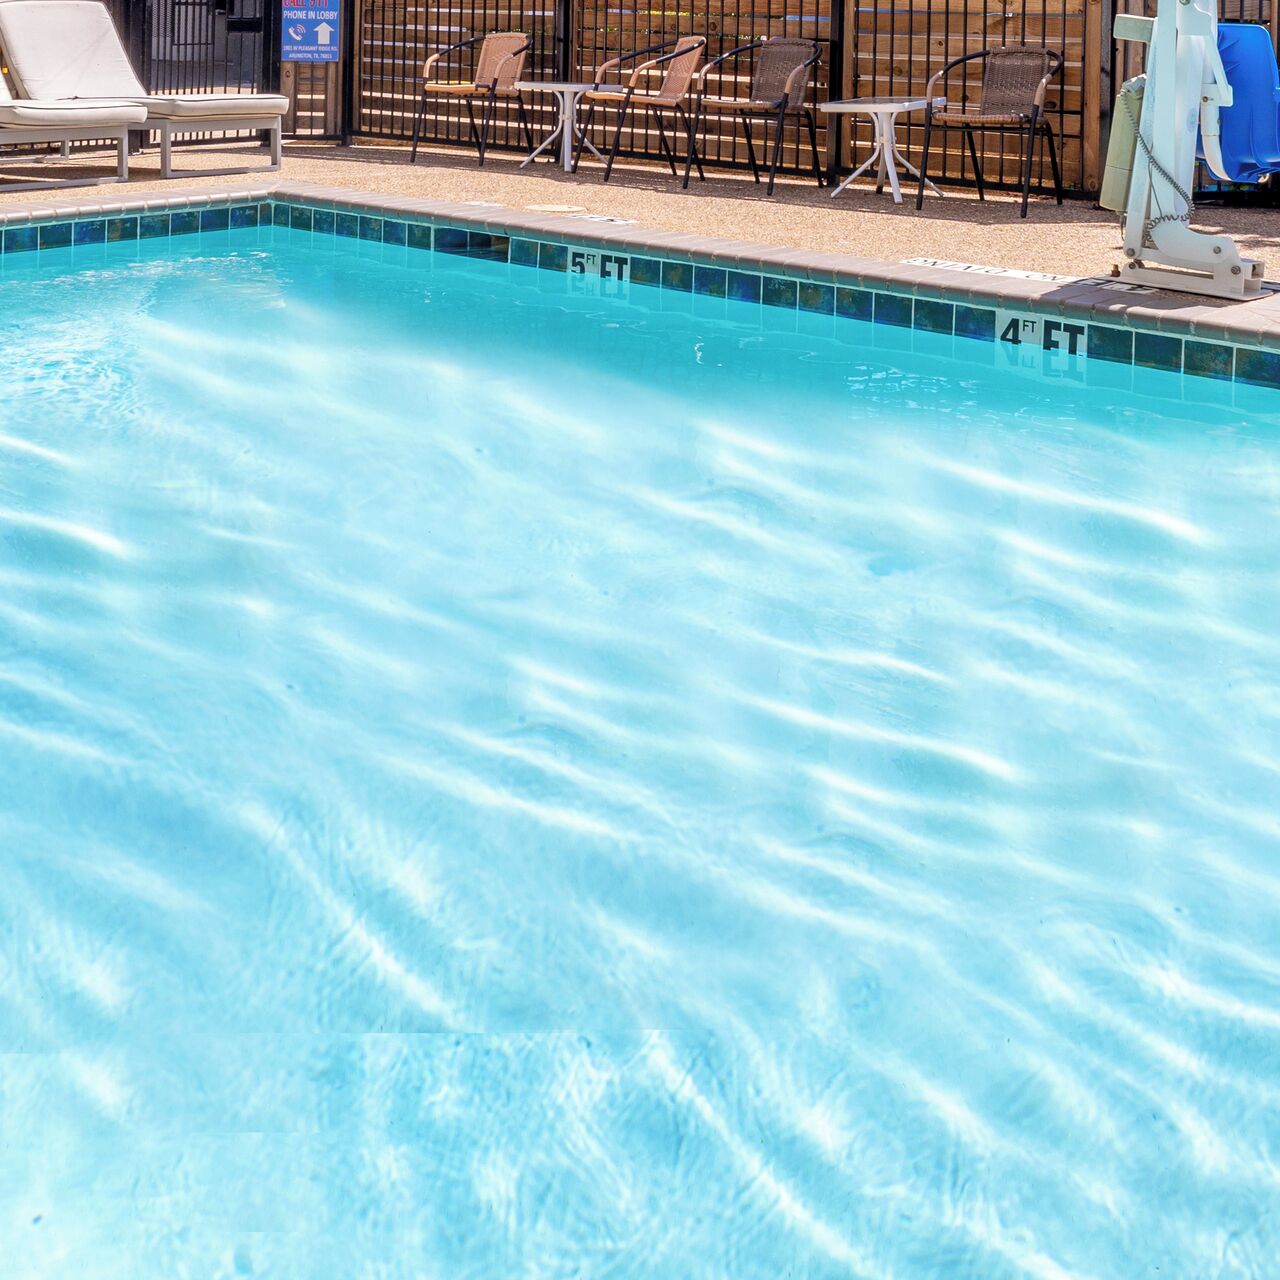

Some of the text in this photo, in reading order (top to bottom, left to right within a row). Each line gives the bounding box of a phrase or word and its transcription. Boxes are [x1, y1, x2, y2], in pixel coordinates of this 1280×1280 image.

[283, 10, 338, 20] PHONE IN LOBBY
[571, 252, 585, 274] 5
[599, 253, 629, 282] FT
[1000, 318, 1021, 345] 4
[1042, 319, 1085, 356] FT
